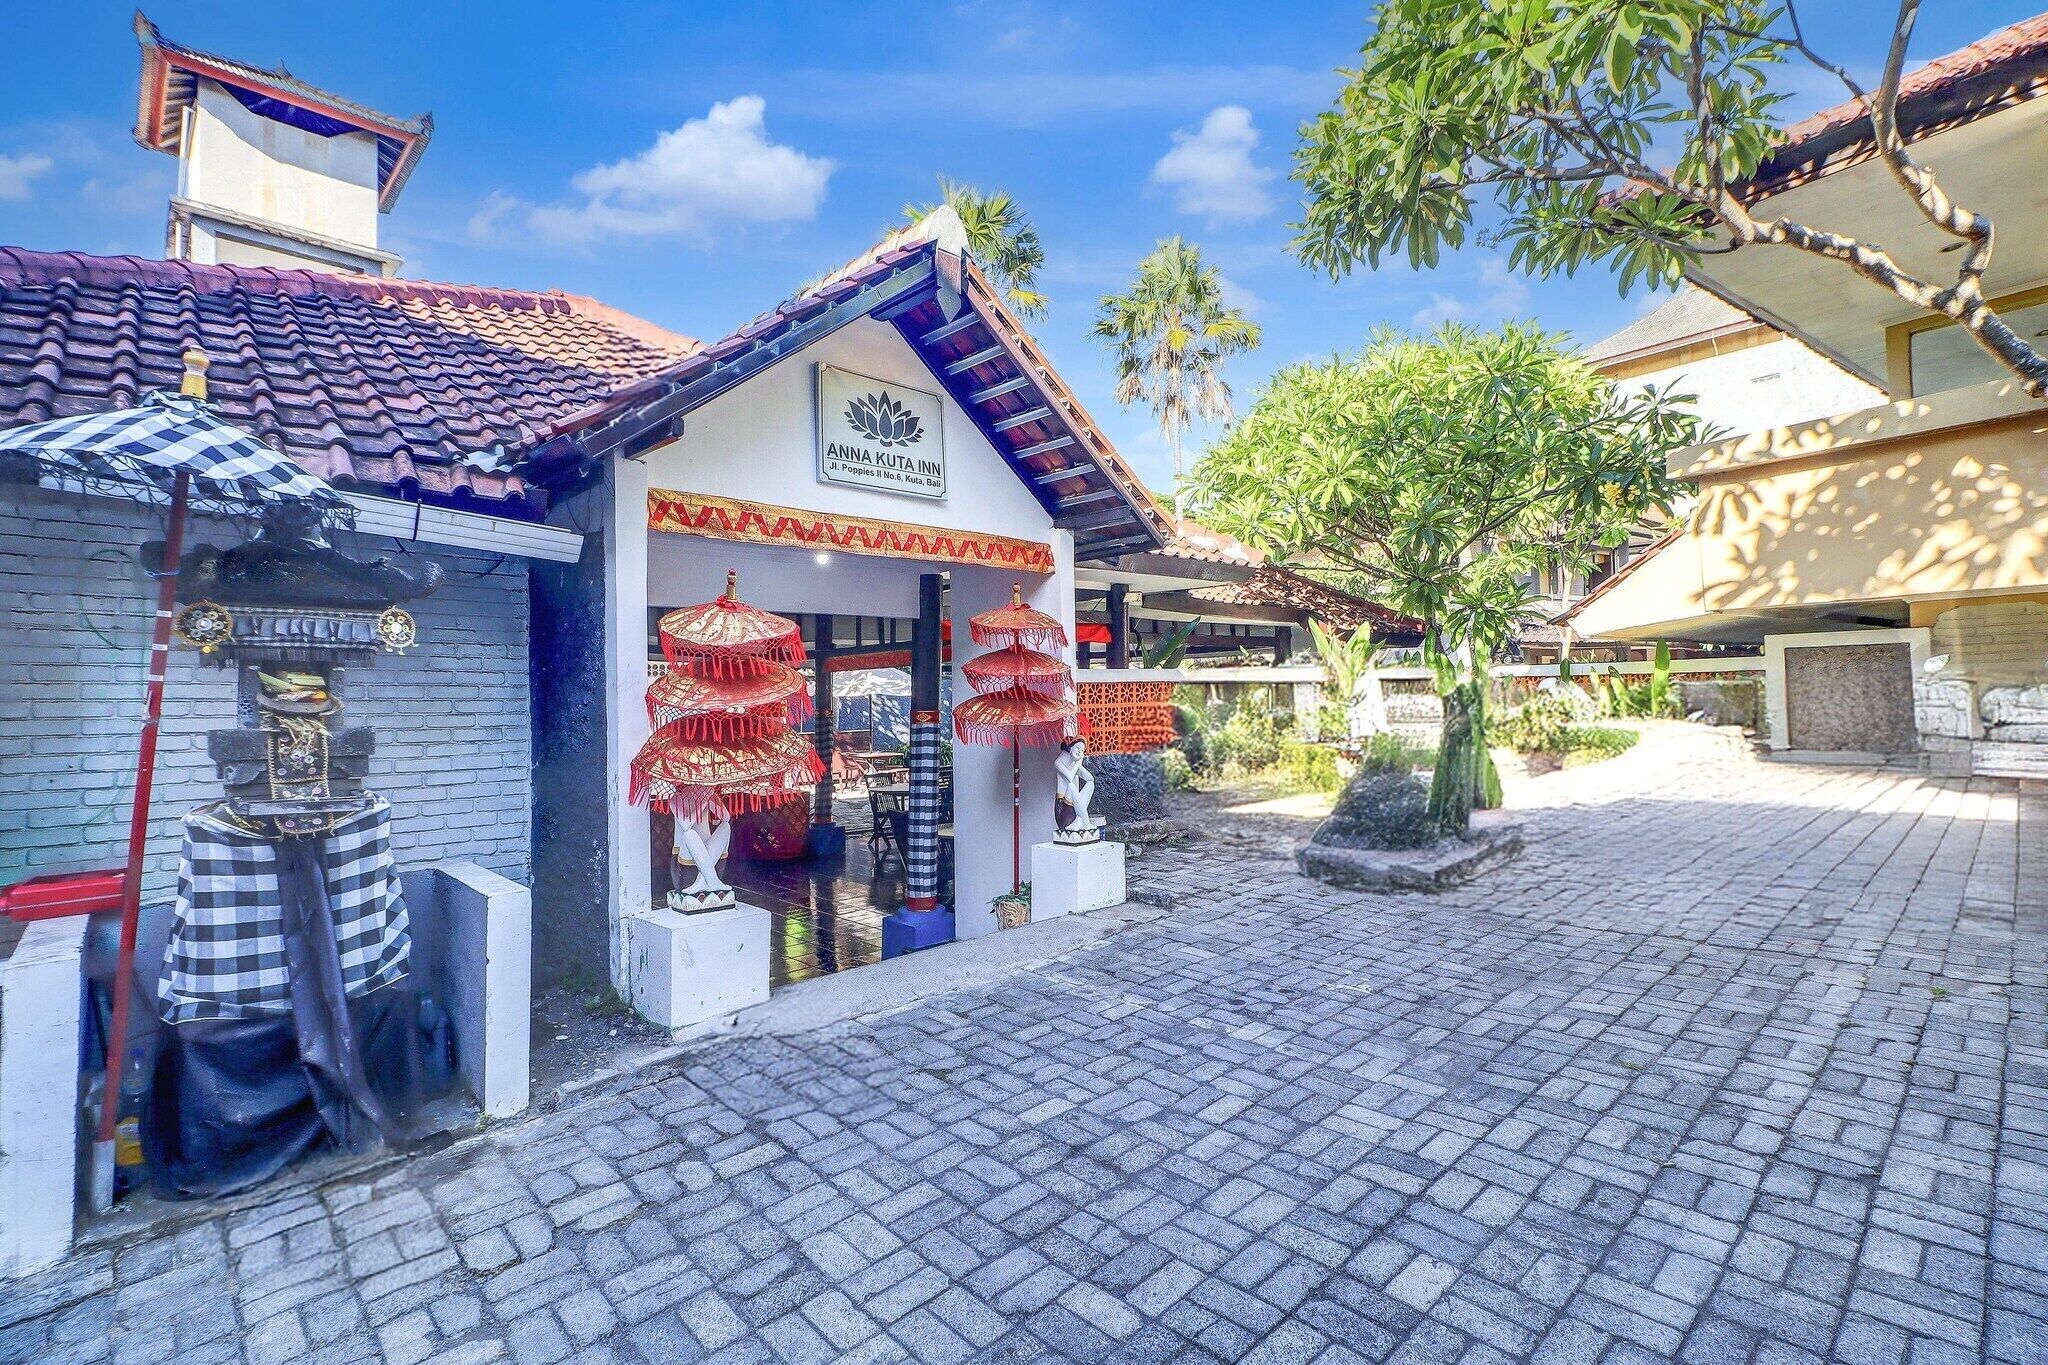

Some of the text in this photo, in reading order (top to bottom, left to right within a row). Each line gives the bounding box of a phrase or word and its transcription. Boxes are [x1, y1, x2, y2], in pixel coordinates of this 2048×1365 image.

[827, 443, 941, 476] ANNA KUTA INN
[842, 464, 874, 477] Poppies
[905, 475, 925, 486] Kuta,
[927, 477, 941, 487] Bali
